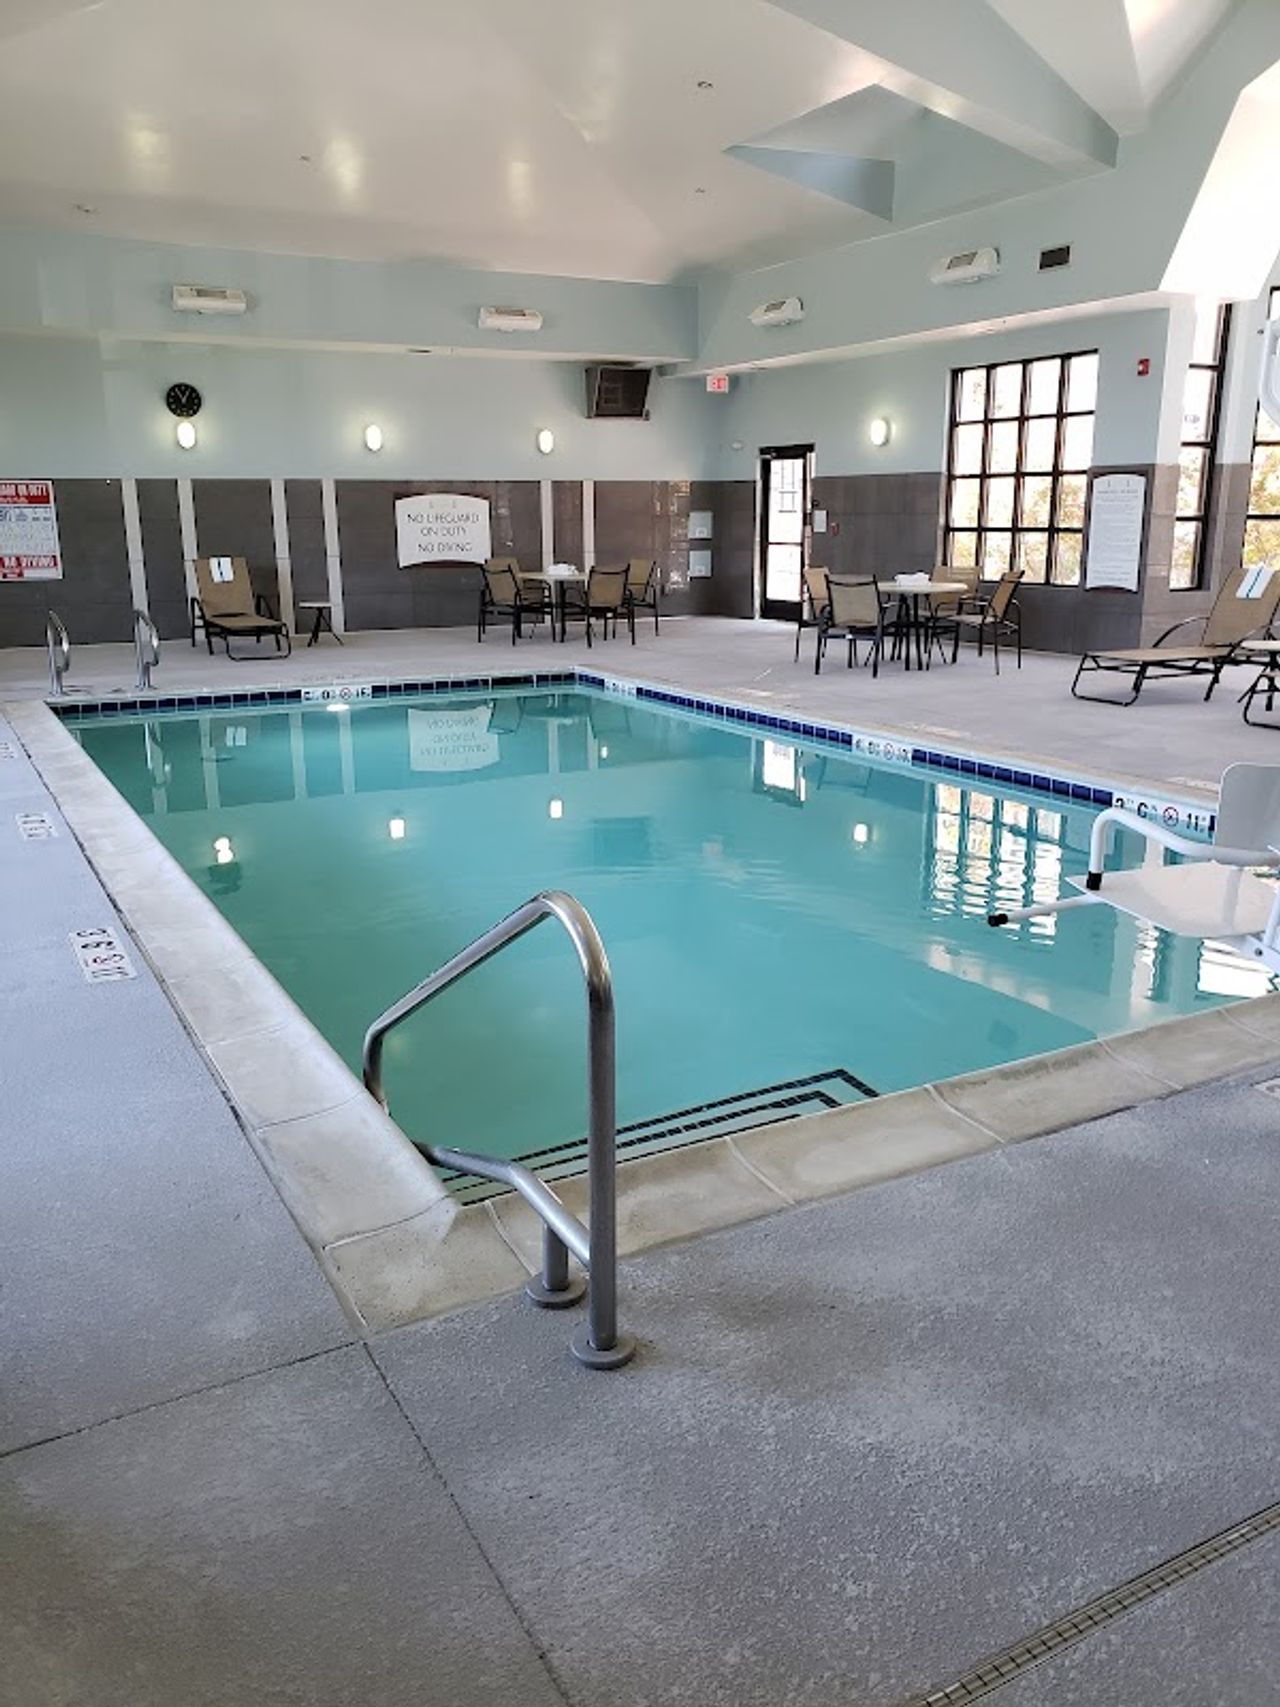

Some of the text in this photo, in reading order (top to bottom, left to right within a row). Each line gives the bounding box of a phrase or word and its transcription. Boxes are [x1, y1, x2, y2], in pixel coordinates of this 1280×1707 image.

[407, 512, 480, 524] NO LIFEGUARD
[420, 526, 467, 537] ON DUTY
[418, 541, 473, 554] NO DIVING
